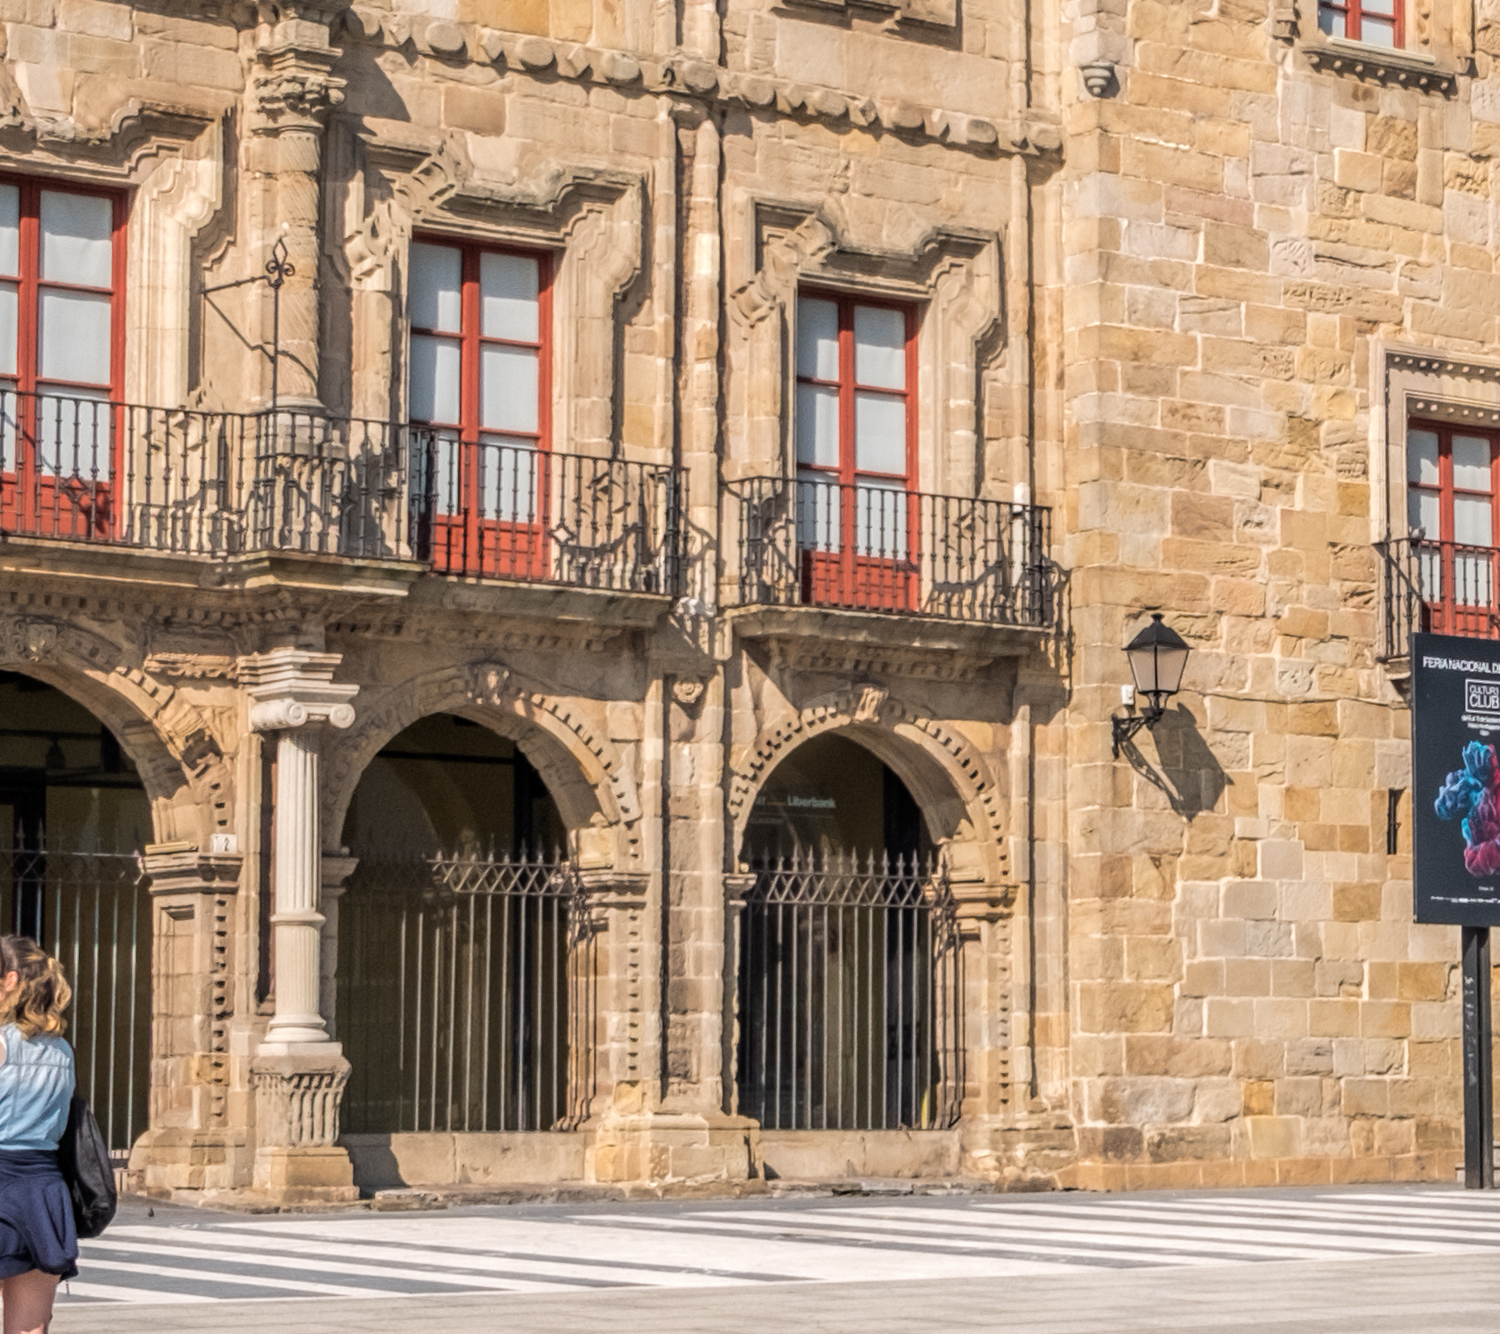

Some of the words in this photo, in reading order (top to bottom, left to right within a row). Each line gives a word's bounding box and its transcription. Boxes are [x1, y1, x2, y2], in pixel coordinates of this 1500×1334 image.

[1423, 656, 1449, 669] FERIA
[1449, 658, 1491, 673] NACIONAL
[1470, 694, 1500, 709] CLUB
